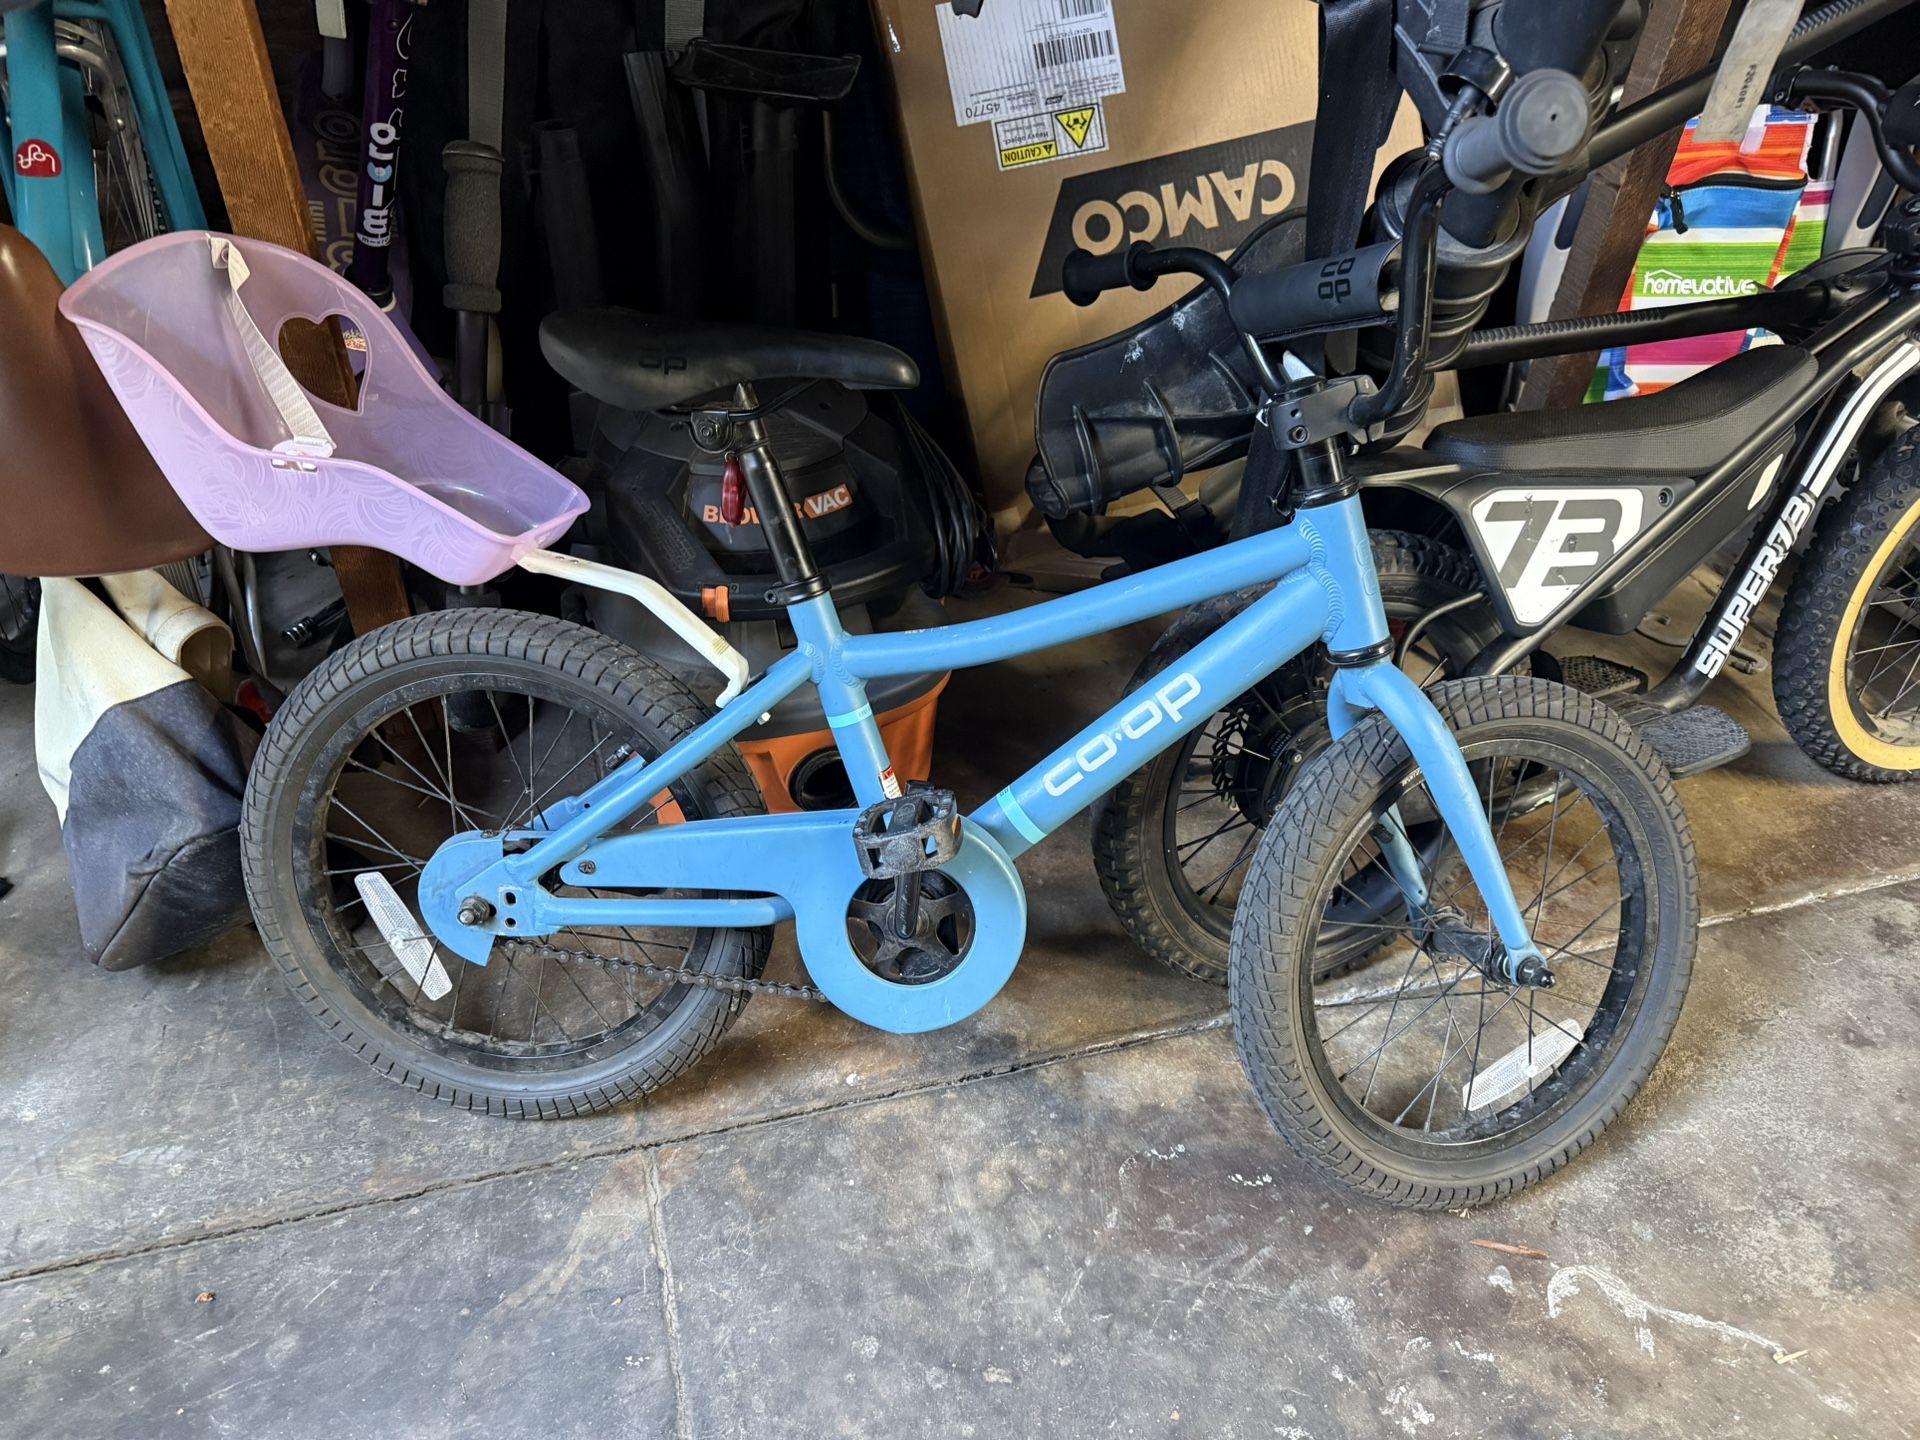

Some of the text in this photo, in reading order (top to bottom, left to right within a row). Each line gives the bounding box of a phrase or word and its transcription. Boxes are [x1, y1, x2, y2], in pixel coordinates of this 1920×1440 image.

[965, 102, 1000, 118] 45770
[1027, 131, 1049, 142] Heavy
[1003, 147, 1042, 163] CAUTION
[1072, 159, 1295, 256] CAMCO
[1642, 271, 1759, 295] homevative
[808, 487, 849, 515] VAC
[1484, 498, 1623, 588] 73
[1694, 492, 1817, 679] SUPER73
